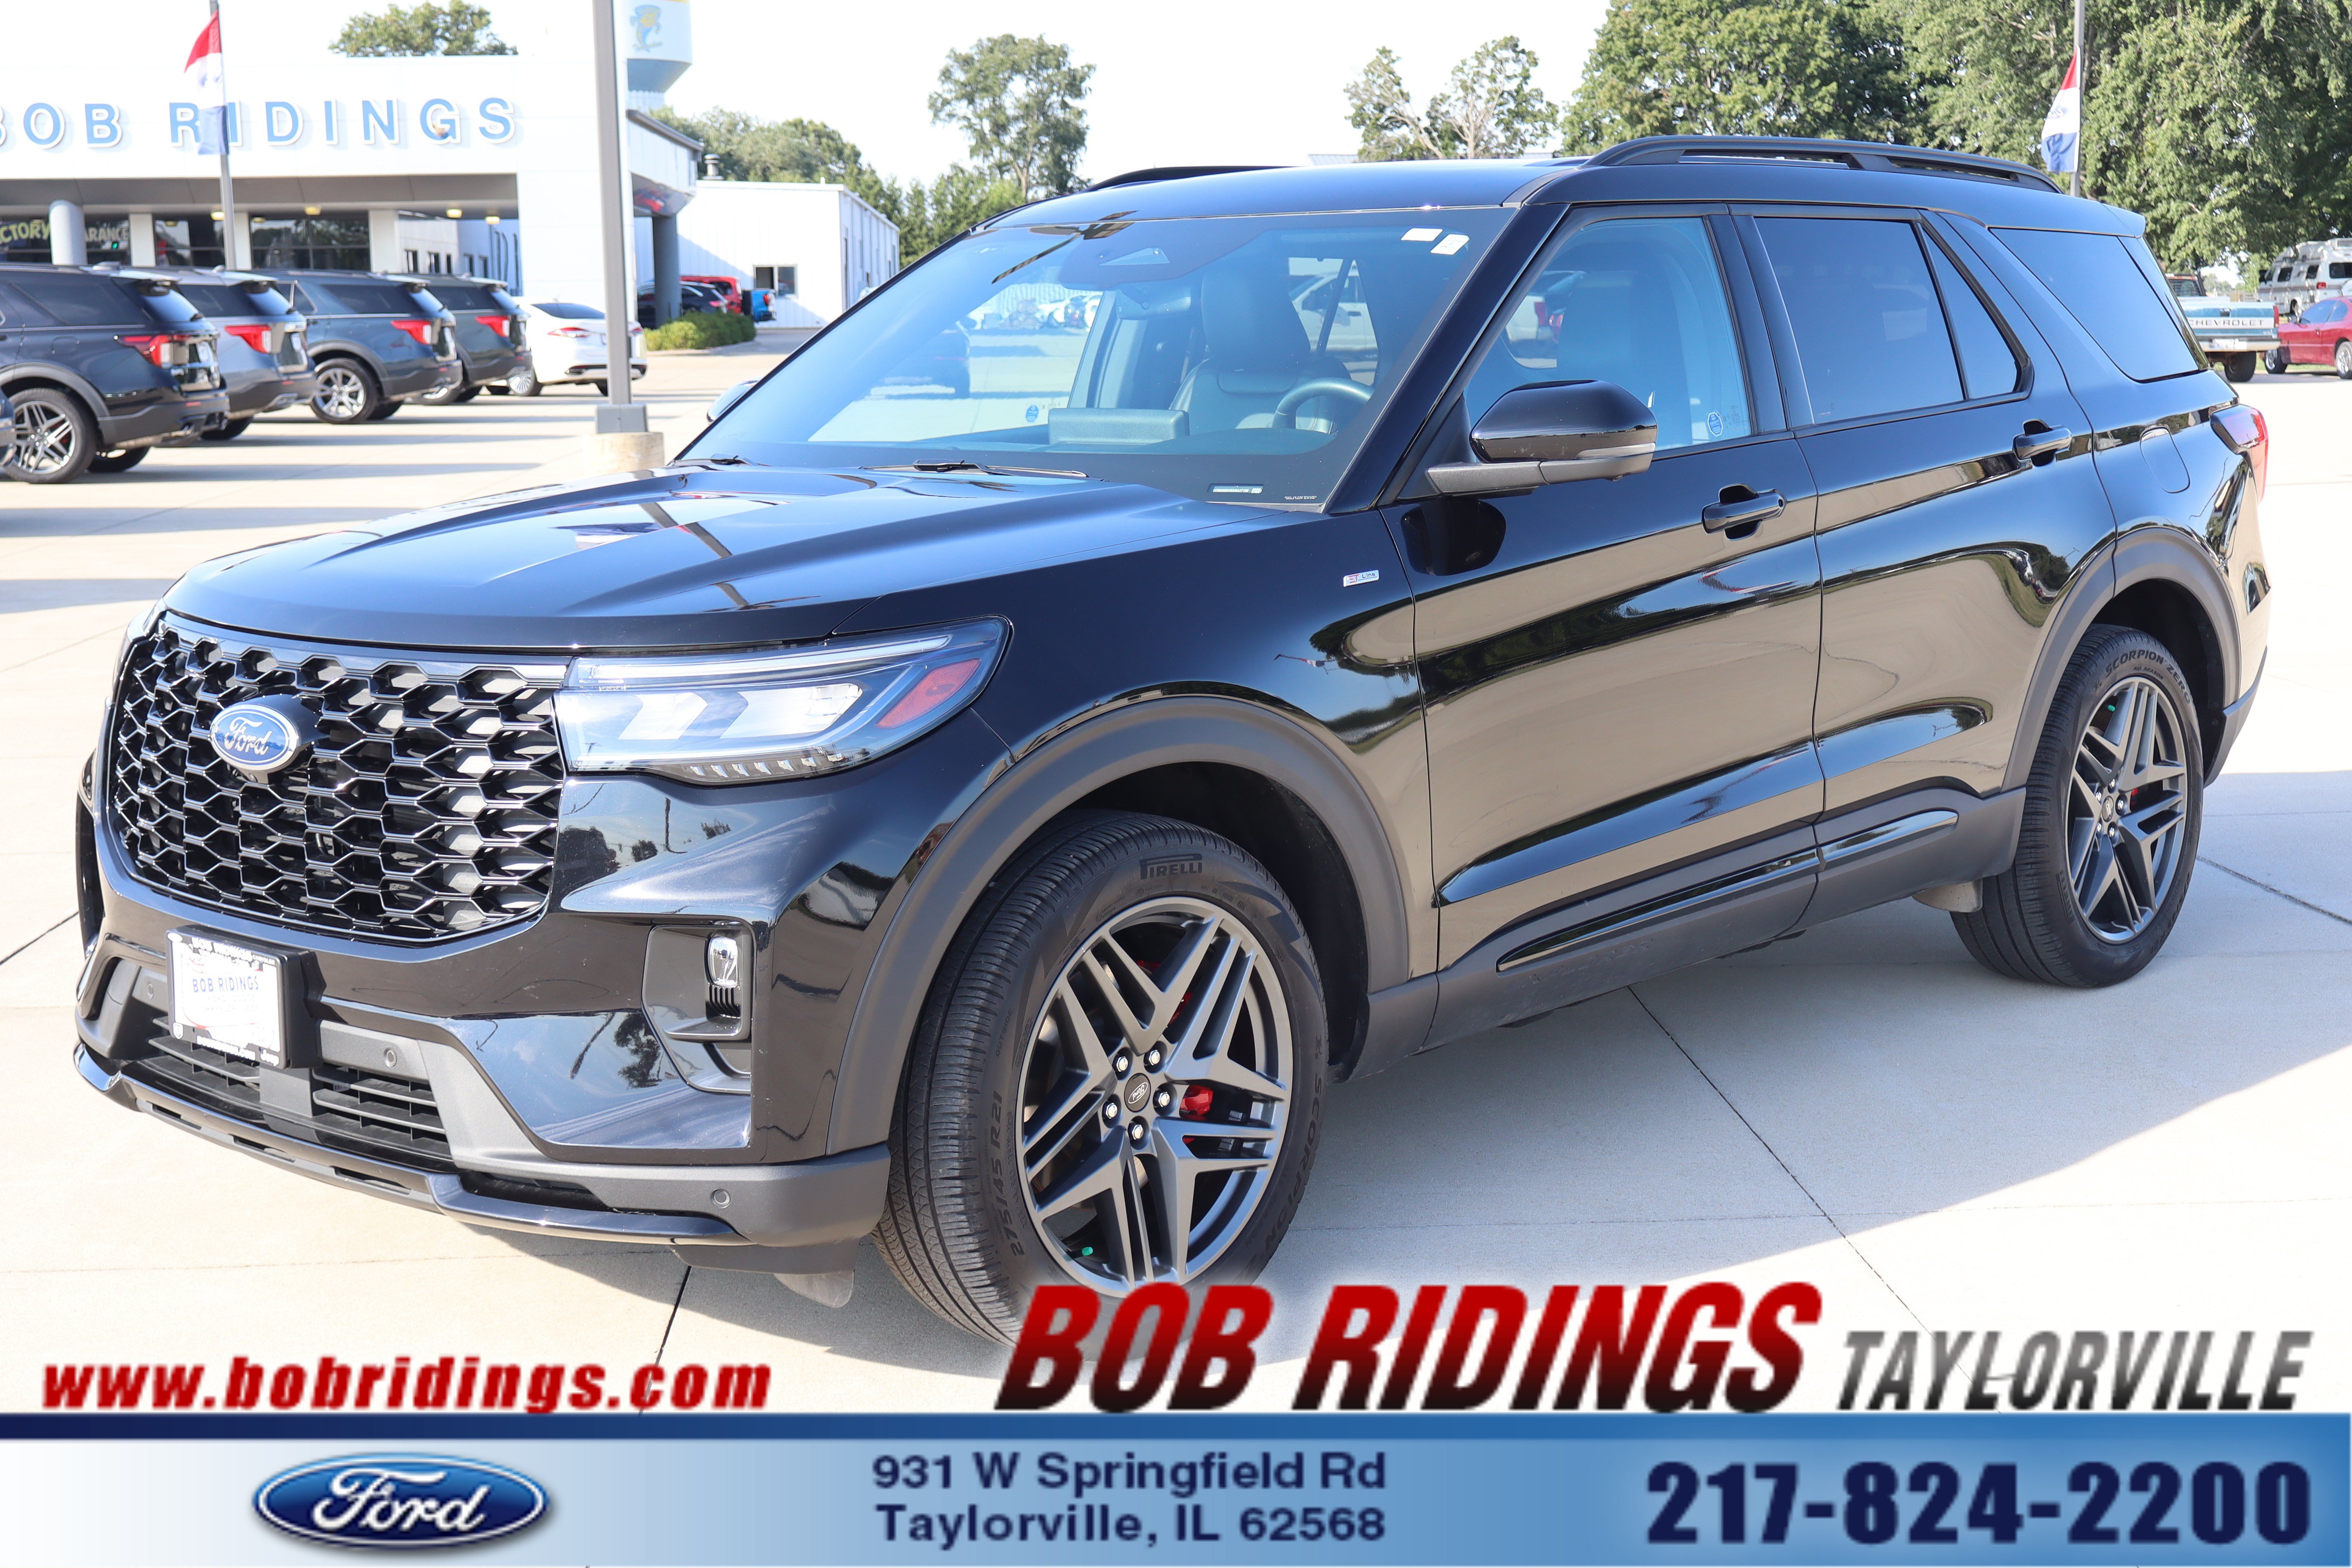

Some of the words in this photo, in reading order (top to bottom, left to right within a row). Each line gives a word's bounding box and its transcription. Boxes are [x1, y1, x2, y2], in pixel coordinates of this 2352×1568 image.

[0, 102, 122, 149] OB
[169, 97, 514, 147] RIDINGS
[0, 222, 50, 244] CTORY
[1348, 574, 1360, 584] ST
[2105, 649, 2164, 678] SCORPION
[2166, 664, 2191, 704] ZERO
[2144, 667, 2165, 680] SEASON
[224, 716, 273, 755] Ford
[1139, 853, 1203, 880] PIRELLI
[192, 978, 214, 993] BOB
[218, 976, 258, 991] RIDINGS
[995, 1008, 1013, 1058] OUTSIDE
[1132, 1084, 1145, 1100] Ford
[990, 1090, 1003, 1150] R21
[991, 1156, 1025, 1256] 275/45
